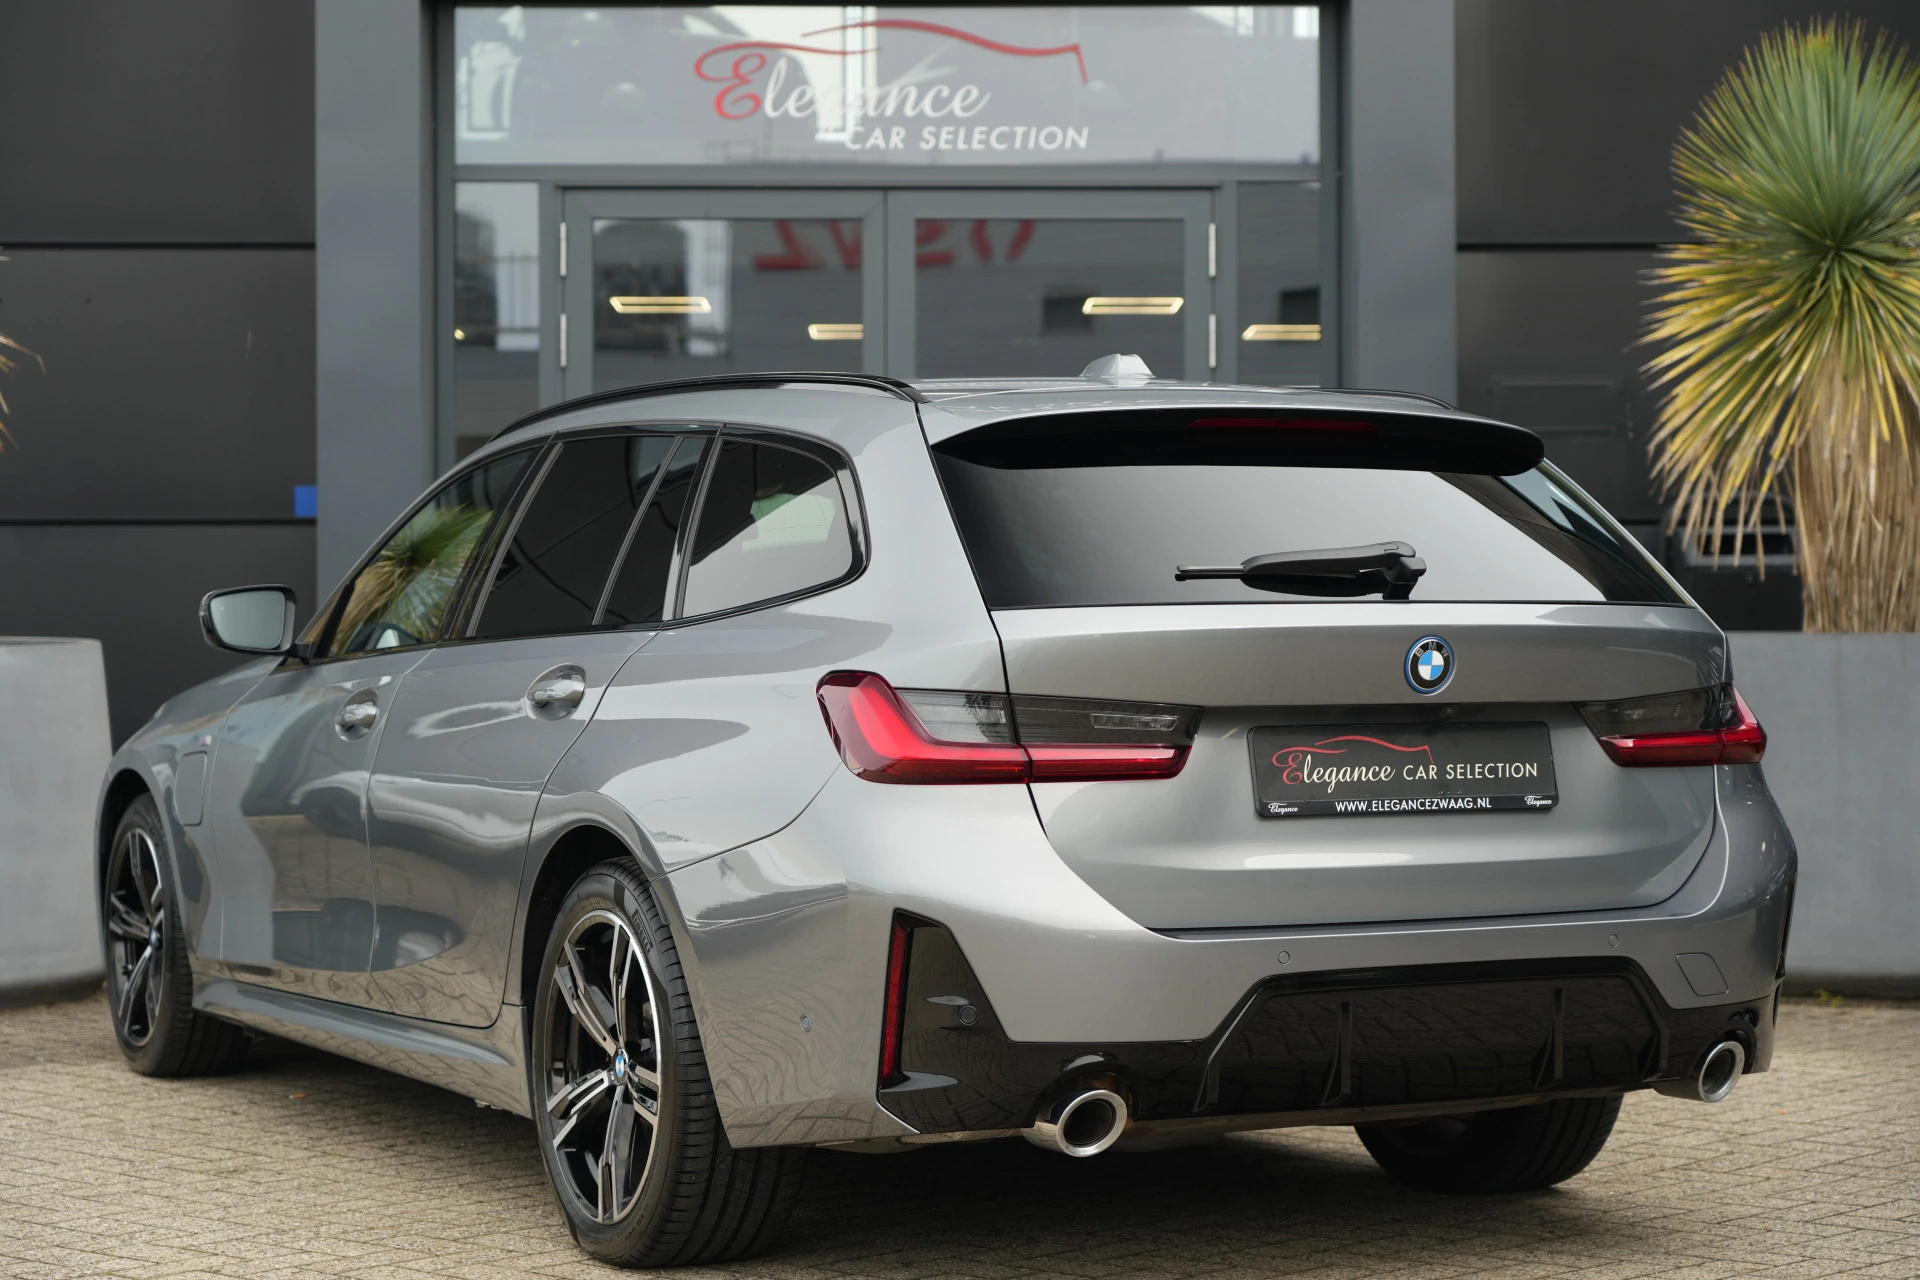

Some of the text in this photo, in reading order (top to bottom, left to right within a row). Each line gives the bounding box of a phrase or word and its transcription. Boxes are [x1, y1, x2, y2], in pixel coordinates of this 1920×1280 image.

[844, 125, 1090, 149] CAR SELECTION
[1414, 641, 1449, 658] BMW
[1272, 748, 1538, 793] Elegance CAR SELECTION
[1268, 802, 1298, 815] Elegance
[1335, 797, 1492, 813] WWW.ELEGANCEZWAAG.NL
[1524, 796, 1553, 808] Elegance
